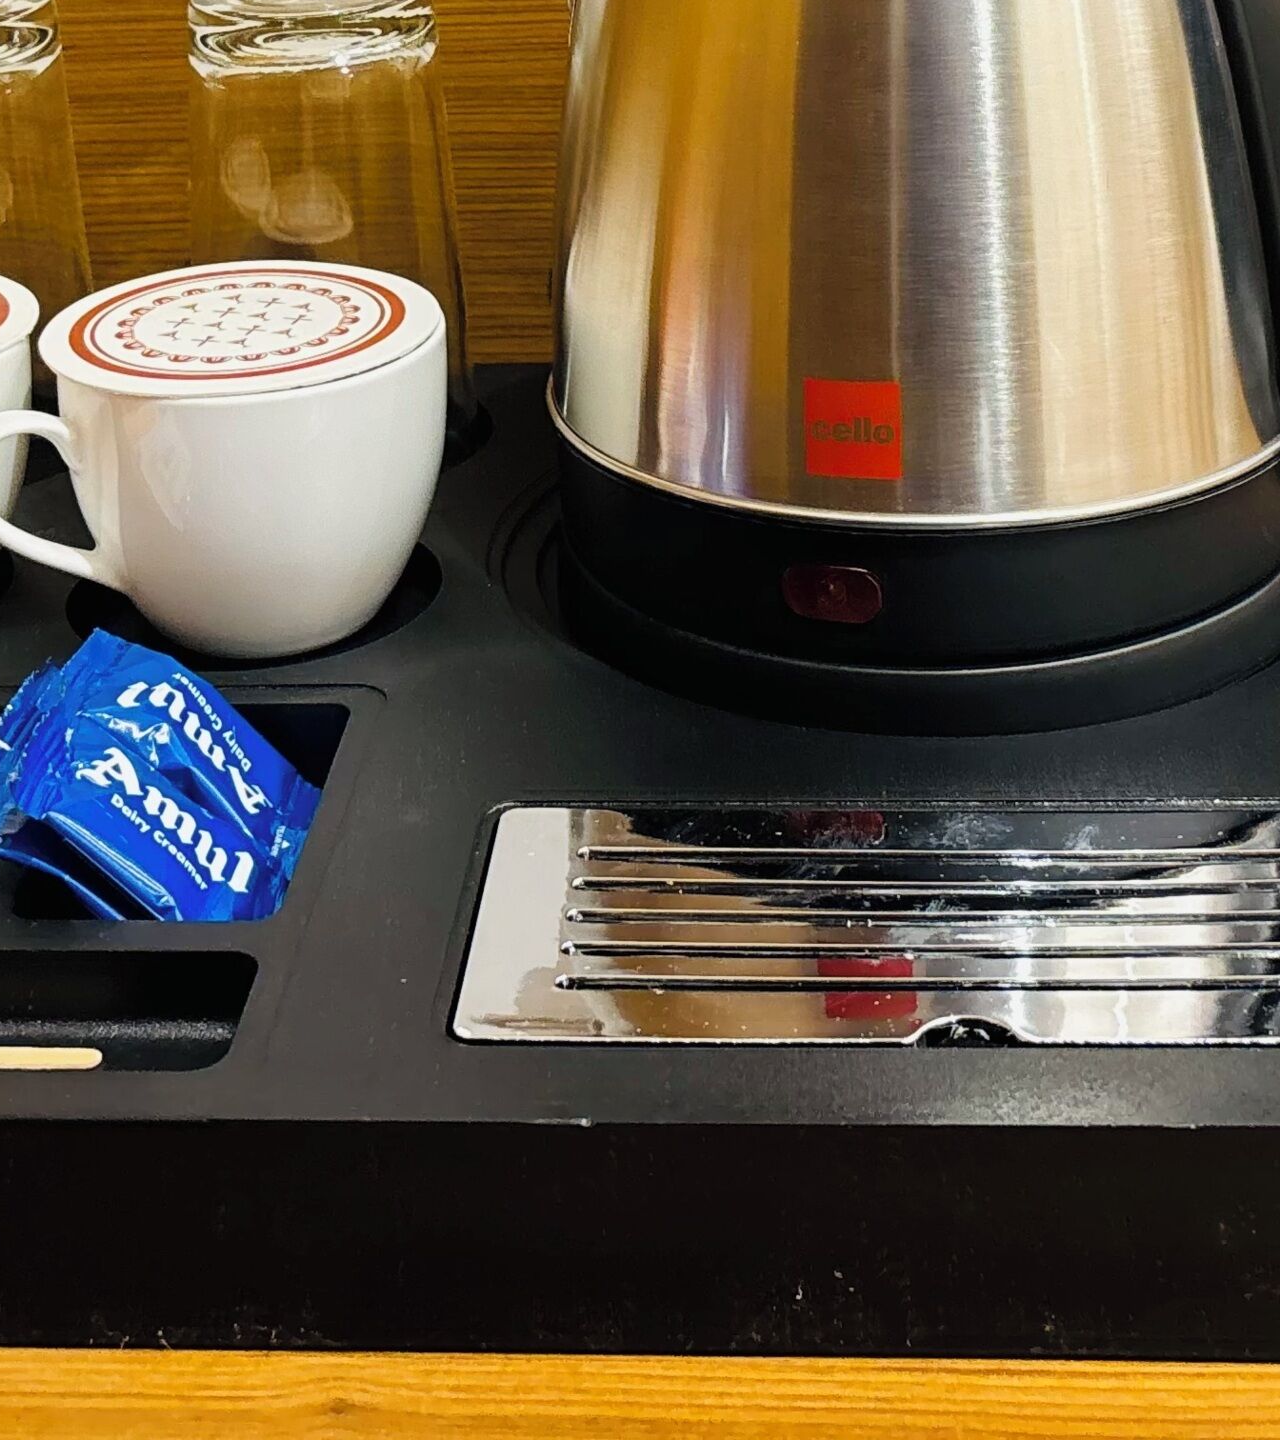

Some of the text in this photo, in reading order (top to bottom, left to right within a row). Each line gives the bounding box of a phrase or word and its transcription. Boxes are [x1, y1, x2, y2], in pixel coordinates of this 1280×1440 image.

[811, 416, 894, 444] cello
[116, 681, 273, 814] Amul
[173, 672, 252, 772] Dairy Creamer
[75, 747, 254, 893] Amul
[110, 793, 208, 890] Dairy Creamer
